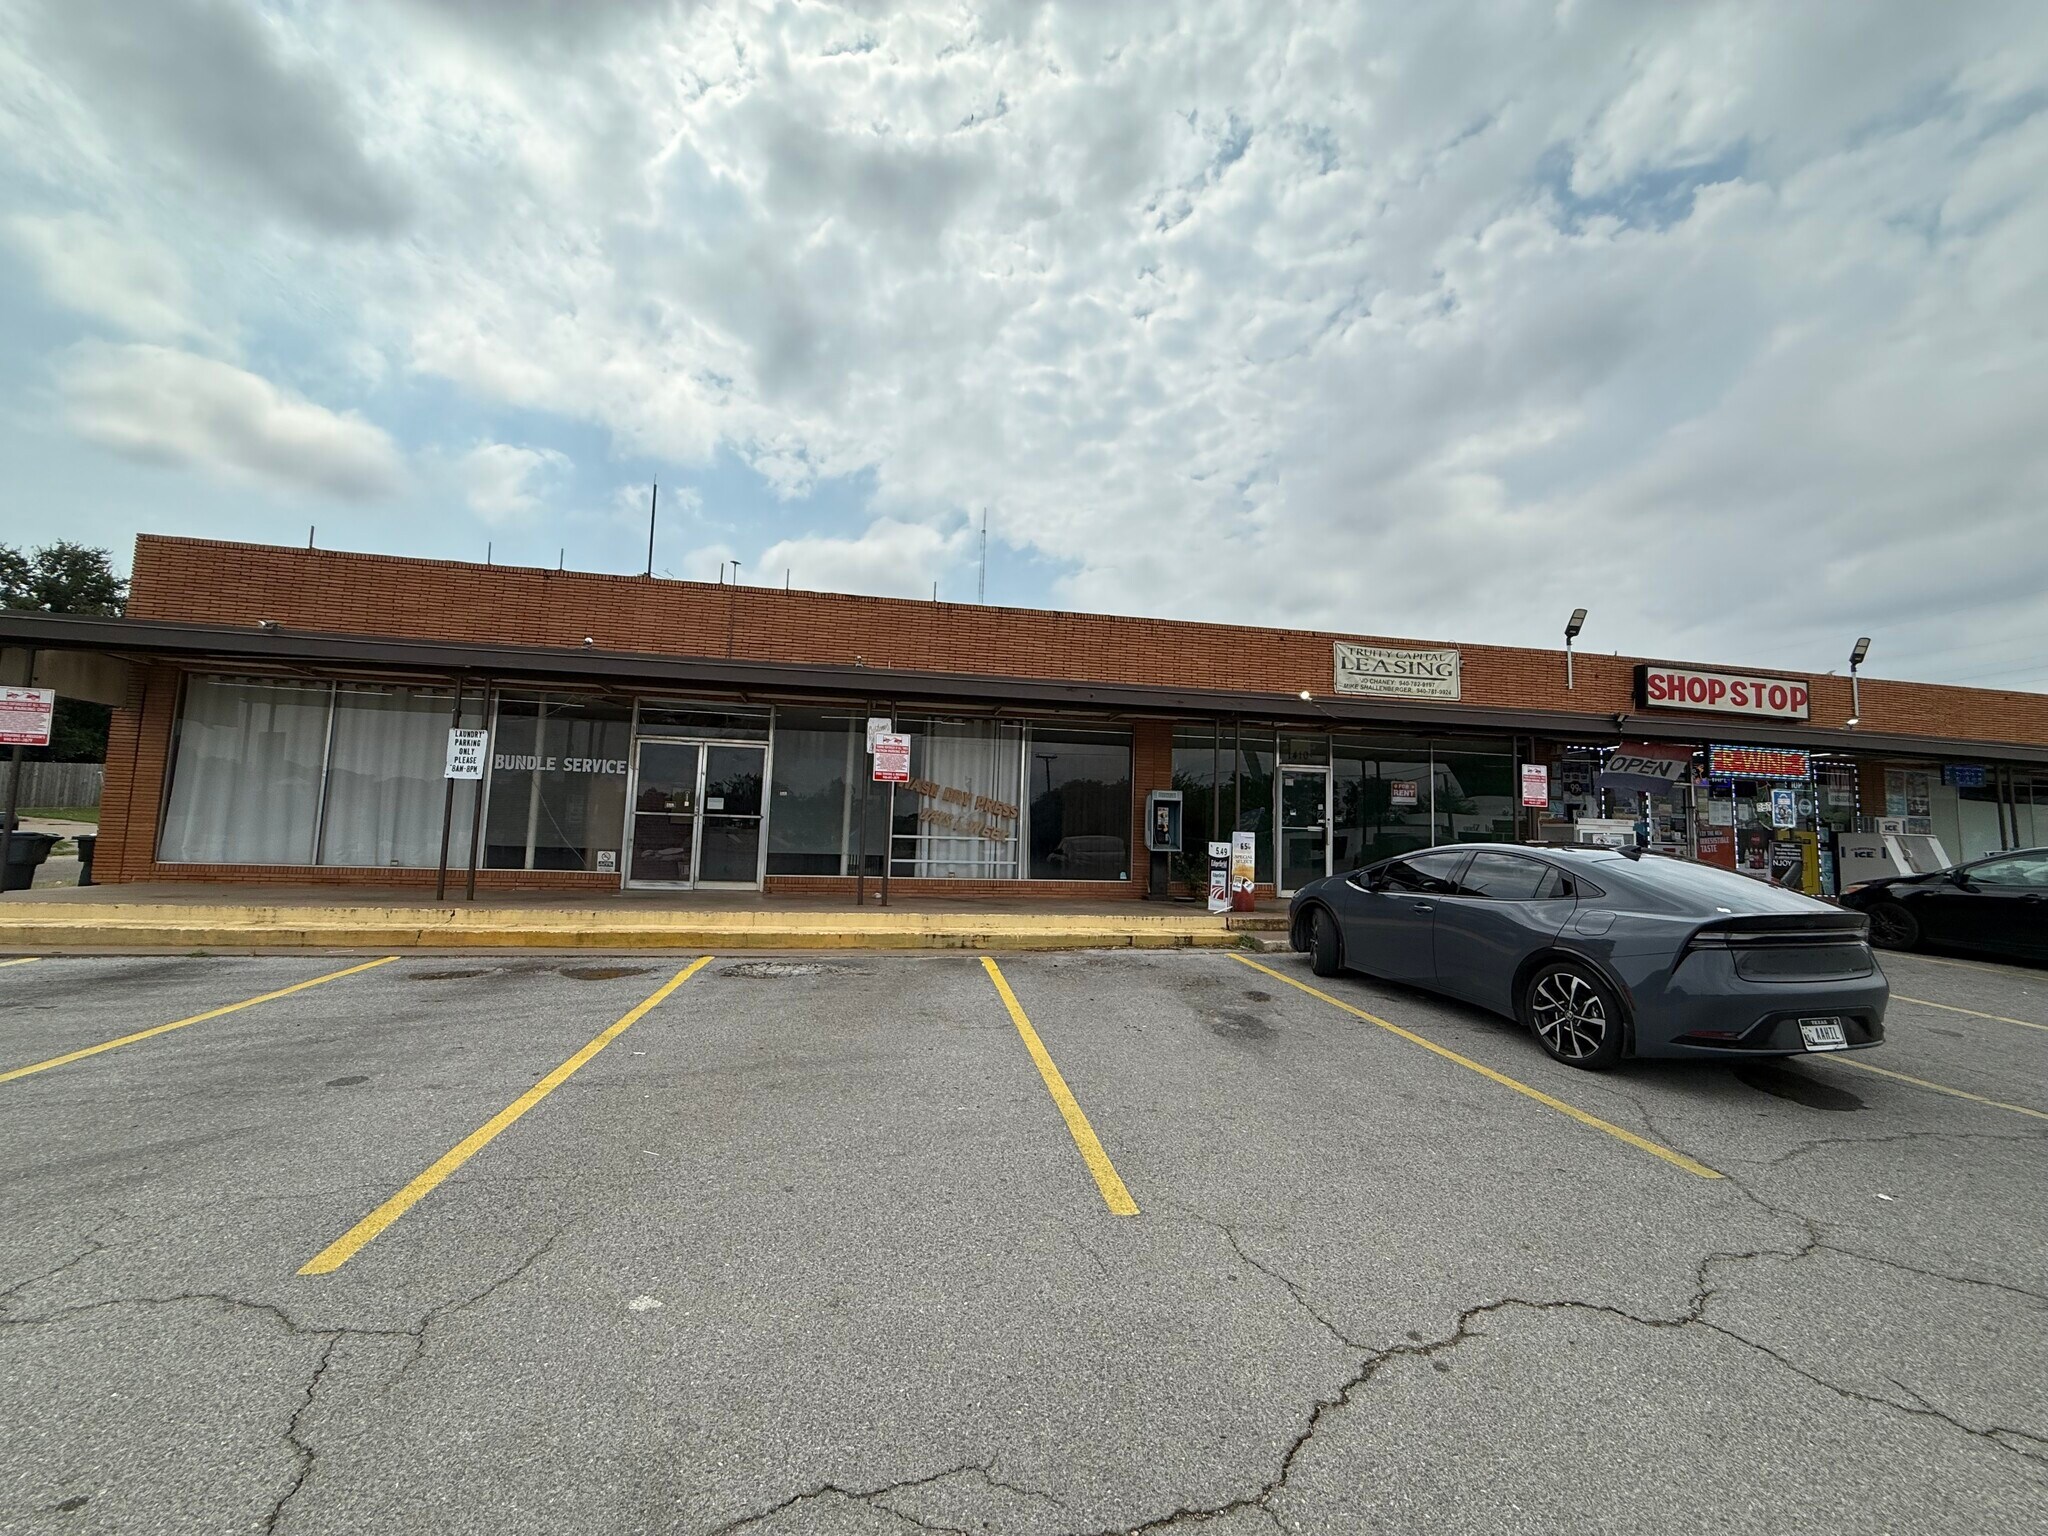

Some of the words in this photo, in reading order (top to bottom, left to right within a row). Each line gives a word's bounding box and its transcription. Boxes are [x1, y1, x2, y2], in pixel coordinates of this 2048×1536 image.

[1396, 651, 1445, 662] CAPITAL
[1341, 656, 1453, 677] LEASING
[1647, 674, 1726, 705] SHOP
[1729, 681, 1808, 713] STOP
[455, 730, 482, 738] LAUNDRY
[454, 738, 481, 747] PARKING
[459, 747, 475, 755] ONLY
[454, 756, 477, 764] PLEASE
[494, 754, 557, 771] BUNDLE
[563, 757, 627, 775] SERVICE
[1609, 756, 1673, 777] OPEN
[1393, 789, 1415, 797] RENT
[942, 786, 973, 807] DRY
[974, 795, 1018, 820] PRESS
[1884, 824, 1898, 832] ICE
[1700, 837, 1730, 845] IRRESISTIBLE
[1701, 845, 1718, 853] TASTE
